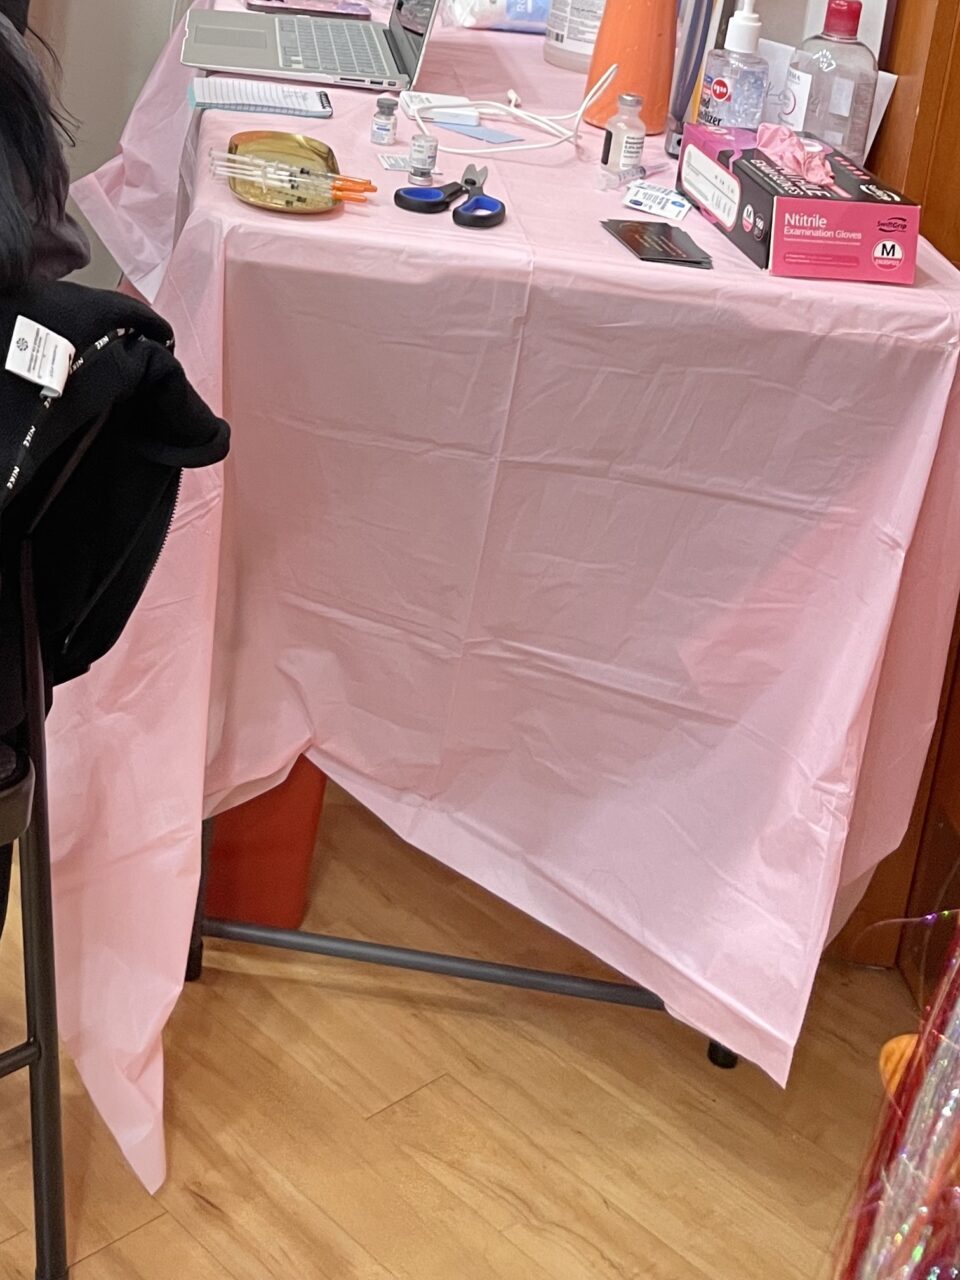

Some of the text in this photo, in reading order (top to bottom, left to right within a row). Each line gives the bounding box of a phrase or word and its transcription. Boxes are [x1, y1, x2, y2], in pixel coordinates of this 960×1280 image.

[784, 212, 827, 228] Ntitrile
[784, 225, 862, 240] Examination Gloves
[881, 243, 896, 257] M
[95, 335, 109, 350] NIKE
[23, 425, 36, 448] NIKE
[6, 465, 20, 489] NIKE
